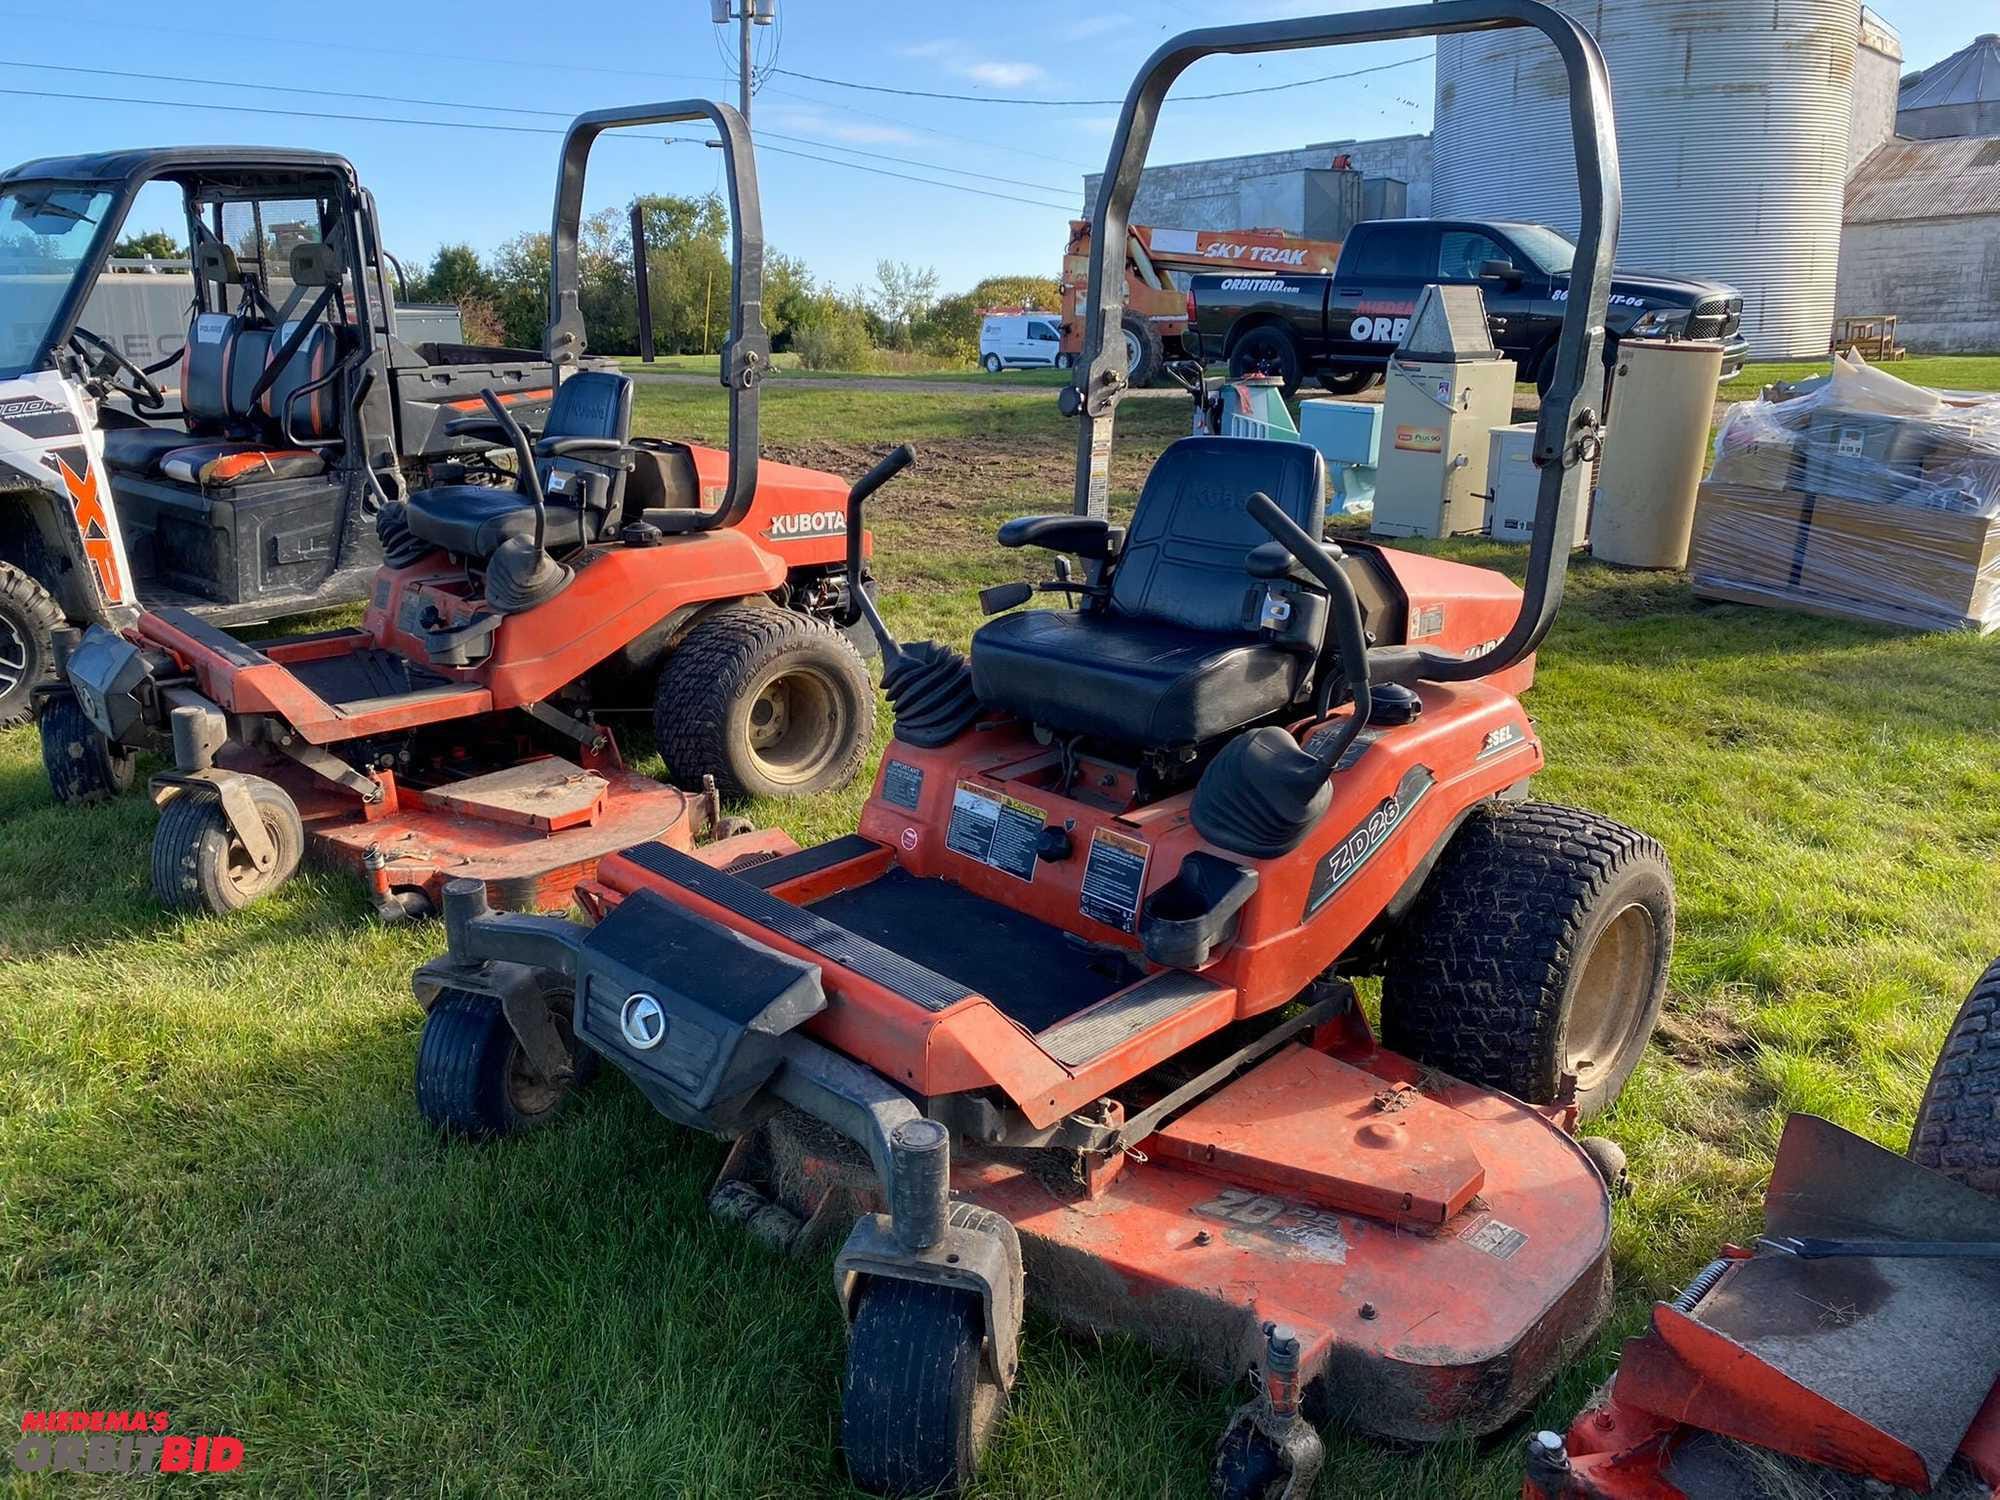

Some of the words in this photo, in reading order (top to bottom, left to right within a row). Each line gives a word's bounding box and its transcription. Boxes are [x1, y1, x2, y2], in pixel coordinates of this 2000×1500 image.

[1204, 243, 1247, 259] SKY
[1250, 246, 1308, 264] TRAK
[54, 452, 124, 604] XP
[770, 511, 847, 535] KUBOTA
